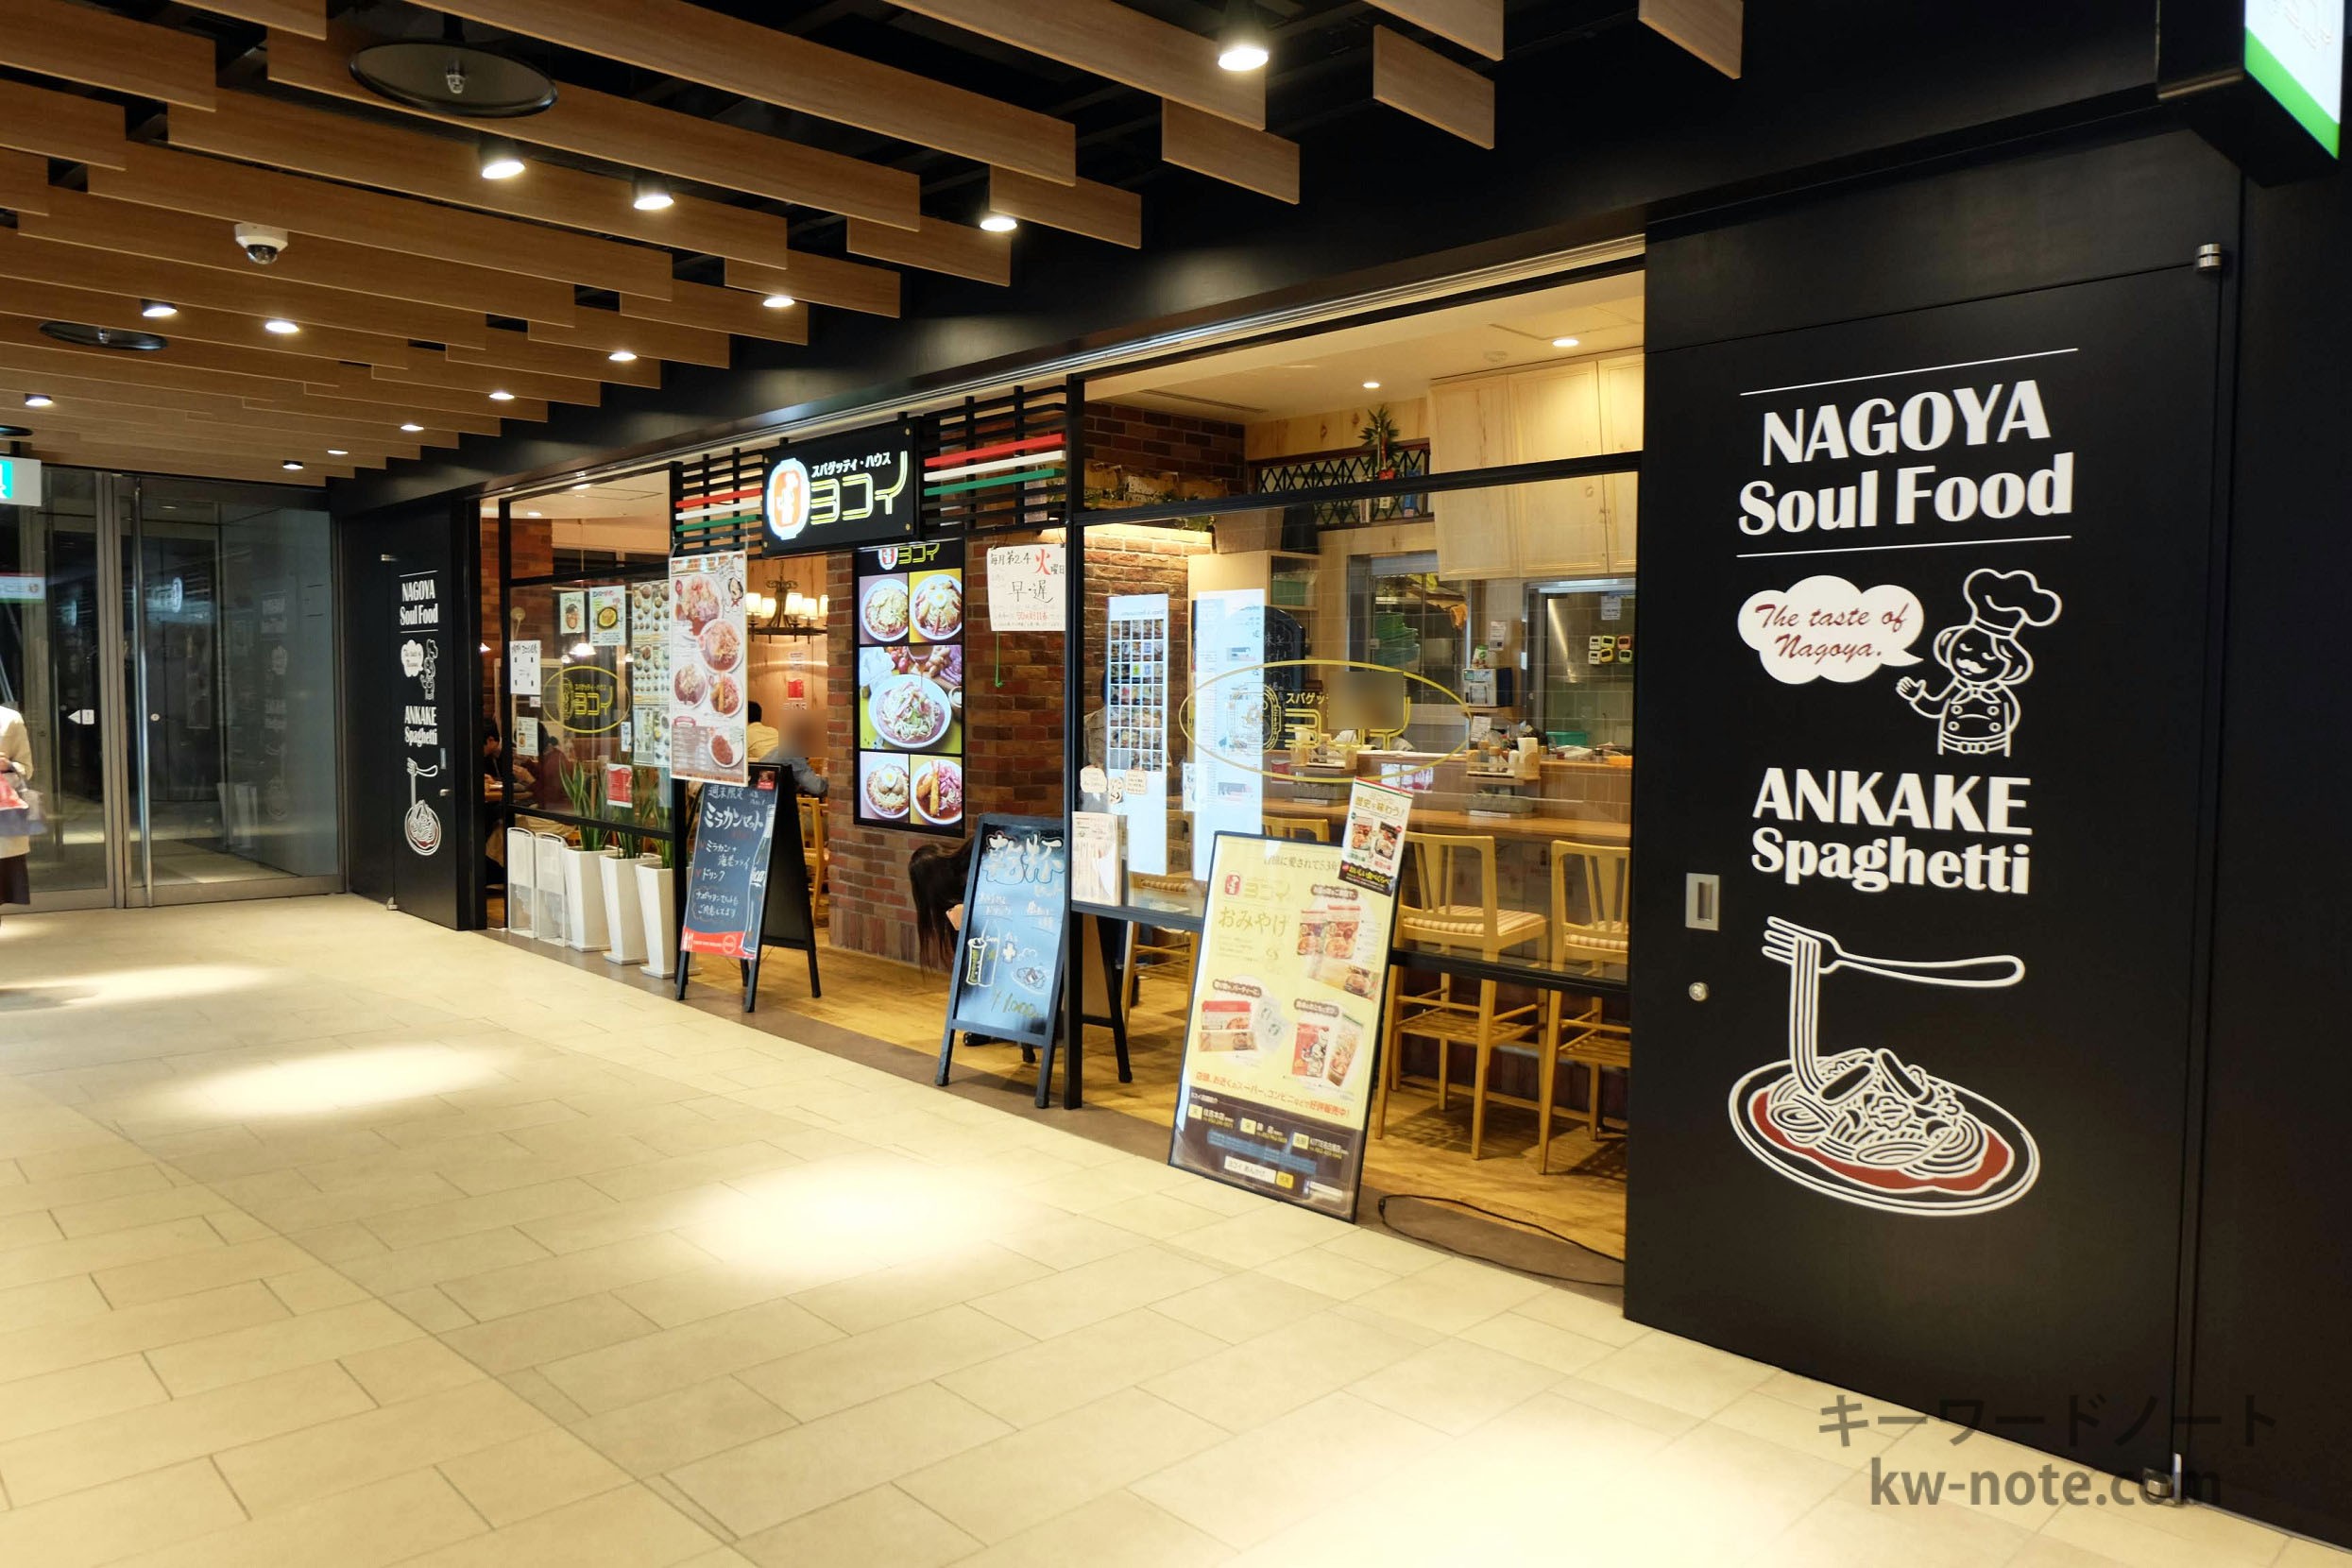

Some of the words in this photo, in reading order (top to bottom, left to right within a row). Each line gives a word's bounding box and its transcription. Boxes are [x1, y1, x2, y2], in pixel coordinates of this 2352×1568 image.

[1763, 380, 2051, 466] NAGOYA
[811, 452, 892, 477] スパゲッティ・ハウス
[810, 451, 908, 525] ヨコイ
[1738, 469, 1879, 536] Soul
[1896, 452, 2074, 524] Food
[897, 543, 940, 564] ヨコイ
[401, 579, 436, 602] NAGOYA
[400, 606, 418, 625] Soul
[418, 603, 439, 624] Food
[1754, 603, 1799, 629] The
[1808, 609, 1870, 626] taste
[1881, 603, 1909, 633] of
[1774, 633, 1883, 665] Nagoya.
[404, 706, 438, 725] ANKAKE
[1751, 767, 2033, 835] ANKAKE
[1751, 827, 2030, 895] Spaghetti
